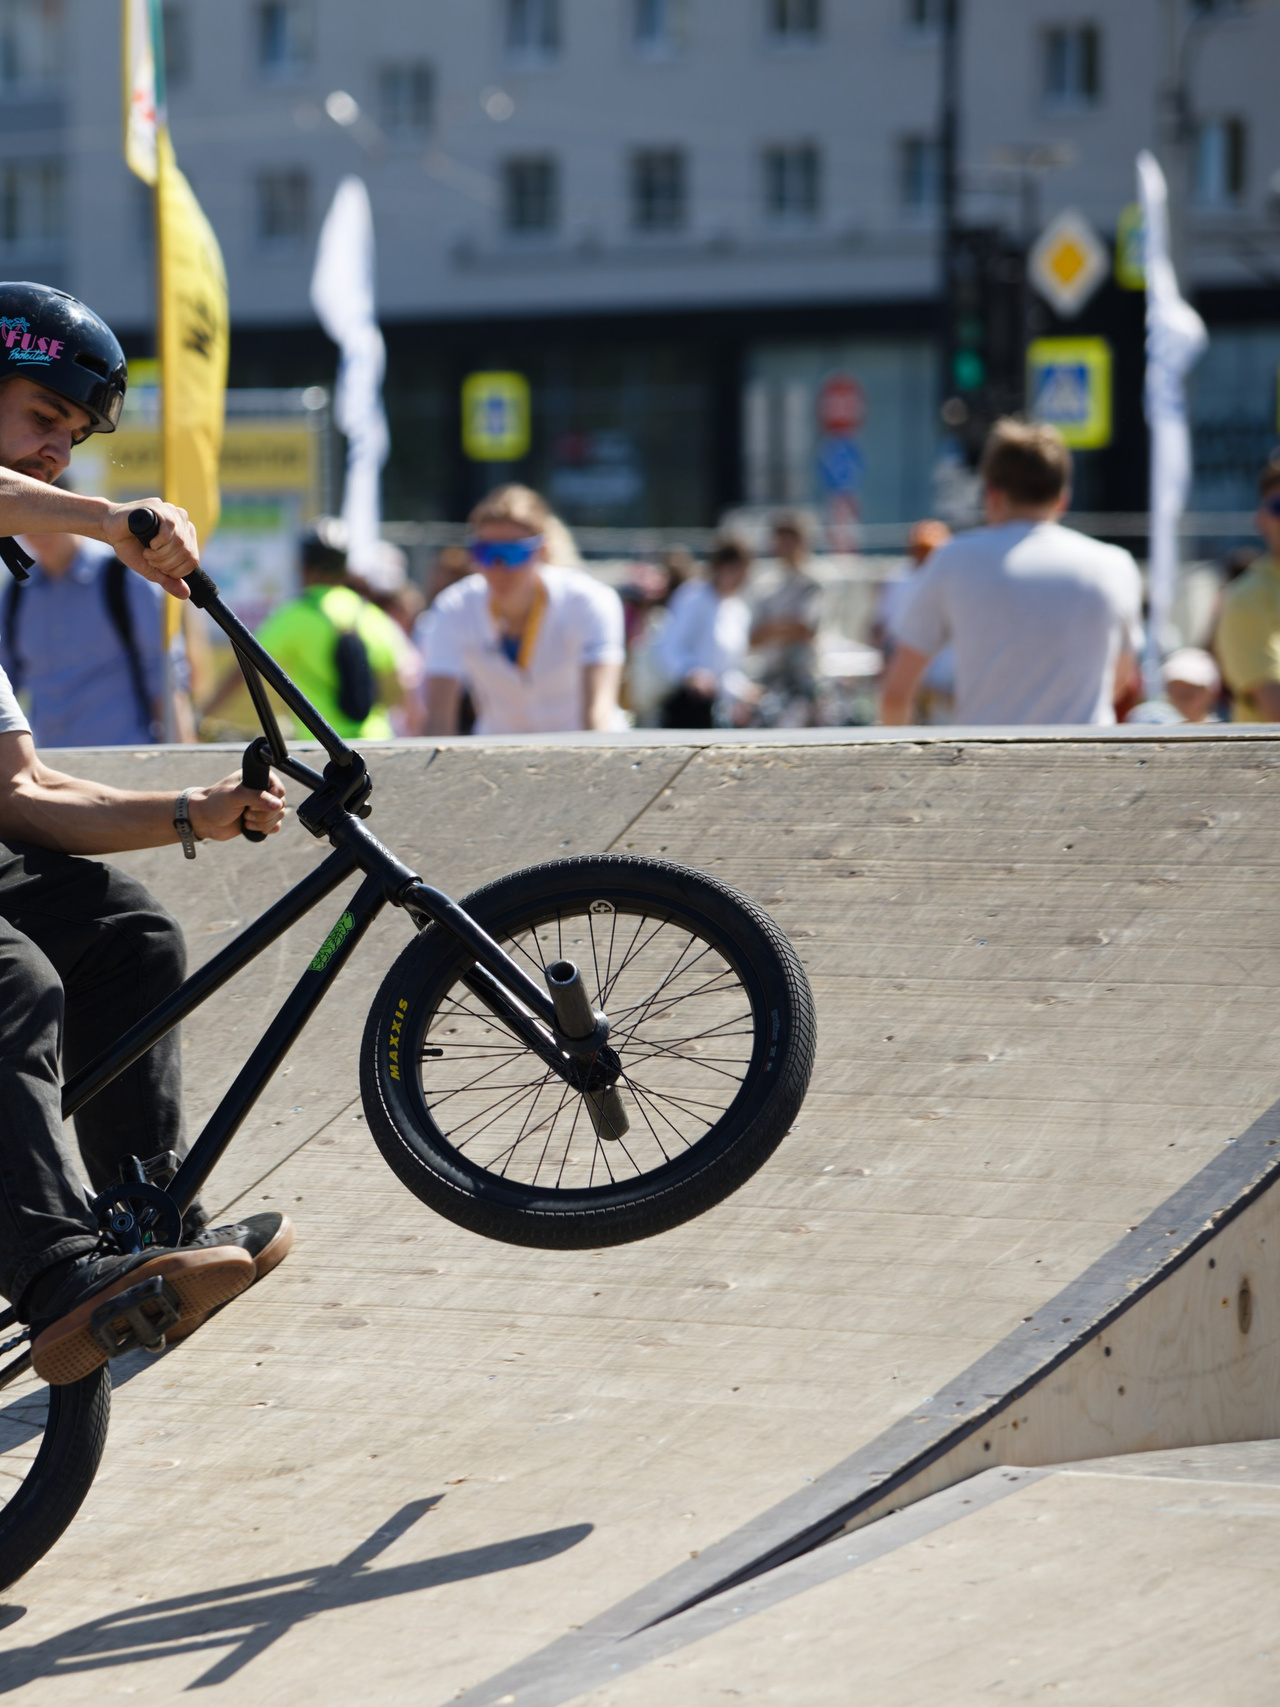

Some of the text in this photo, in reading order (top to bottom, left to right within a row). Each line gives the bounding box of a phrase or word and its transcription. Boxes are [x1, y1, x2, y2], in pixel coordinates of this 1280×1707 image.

[5, 330, 65, 359] FUSE
[8, 348, 54, 363] Protection
[389, 998, 409, 1081] MAXXIS
